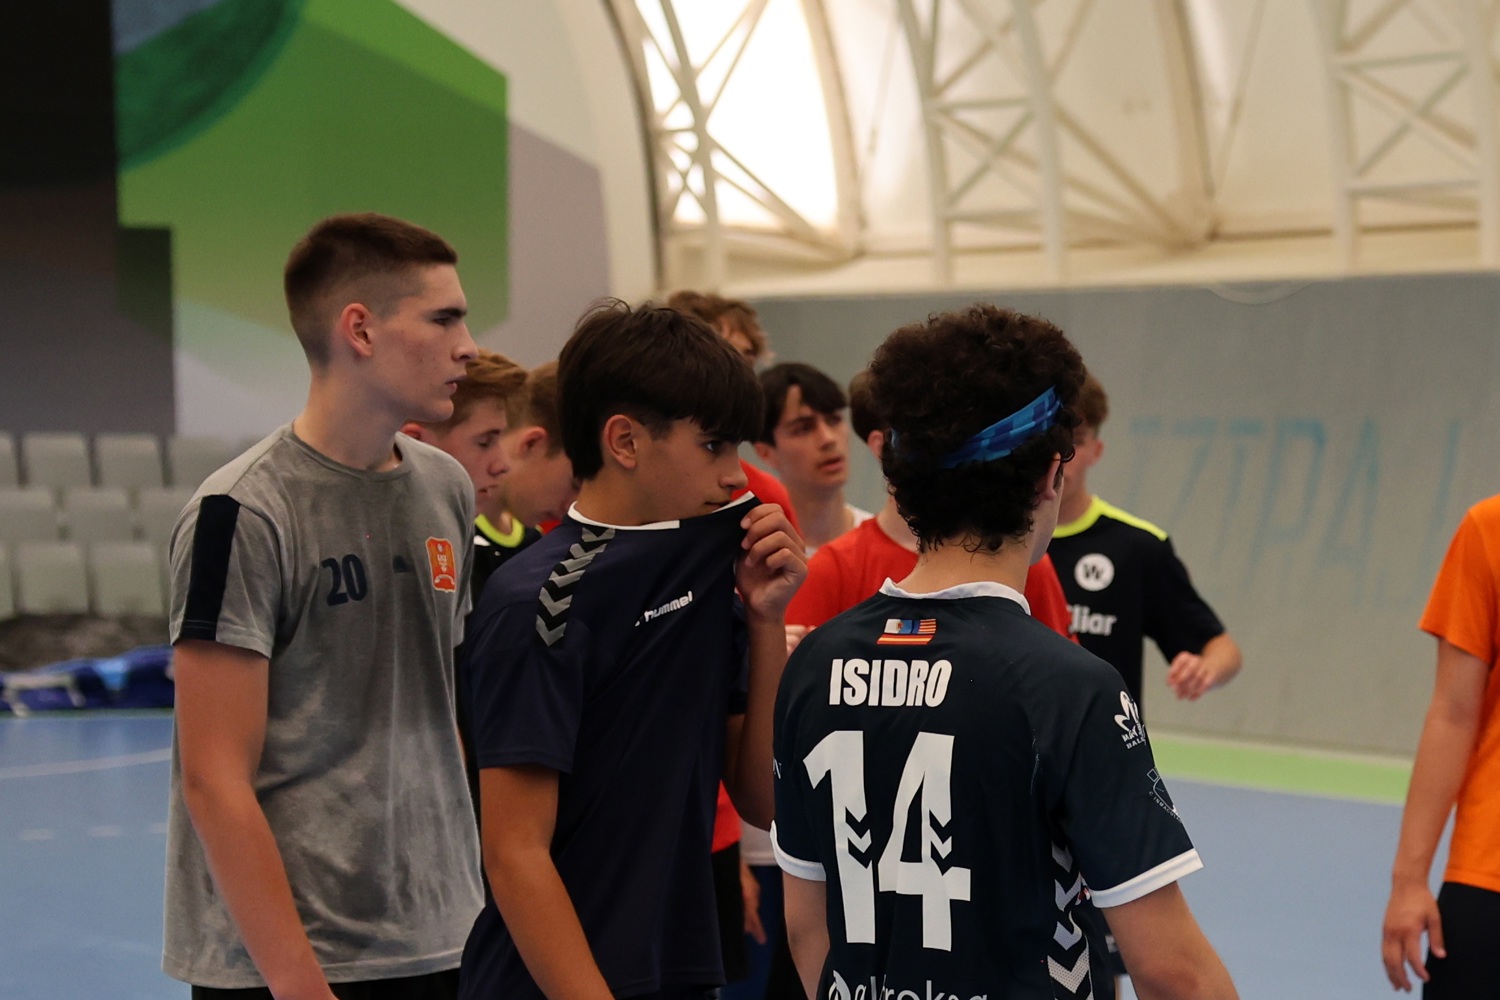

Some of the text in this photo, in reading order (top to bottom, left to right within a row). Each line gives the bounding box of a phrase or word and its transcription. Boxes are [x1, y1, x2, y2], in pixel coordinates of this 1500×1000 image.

[320, 554, 368, 606] 20
[828, 658, 953, 708] ISIDRO
[802, 730, 972, 953] 14
